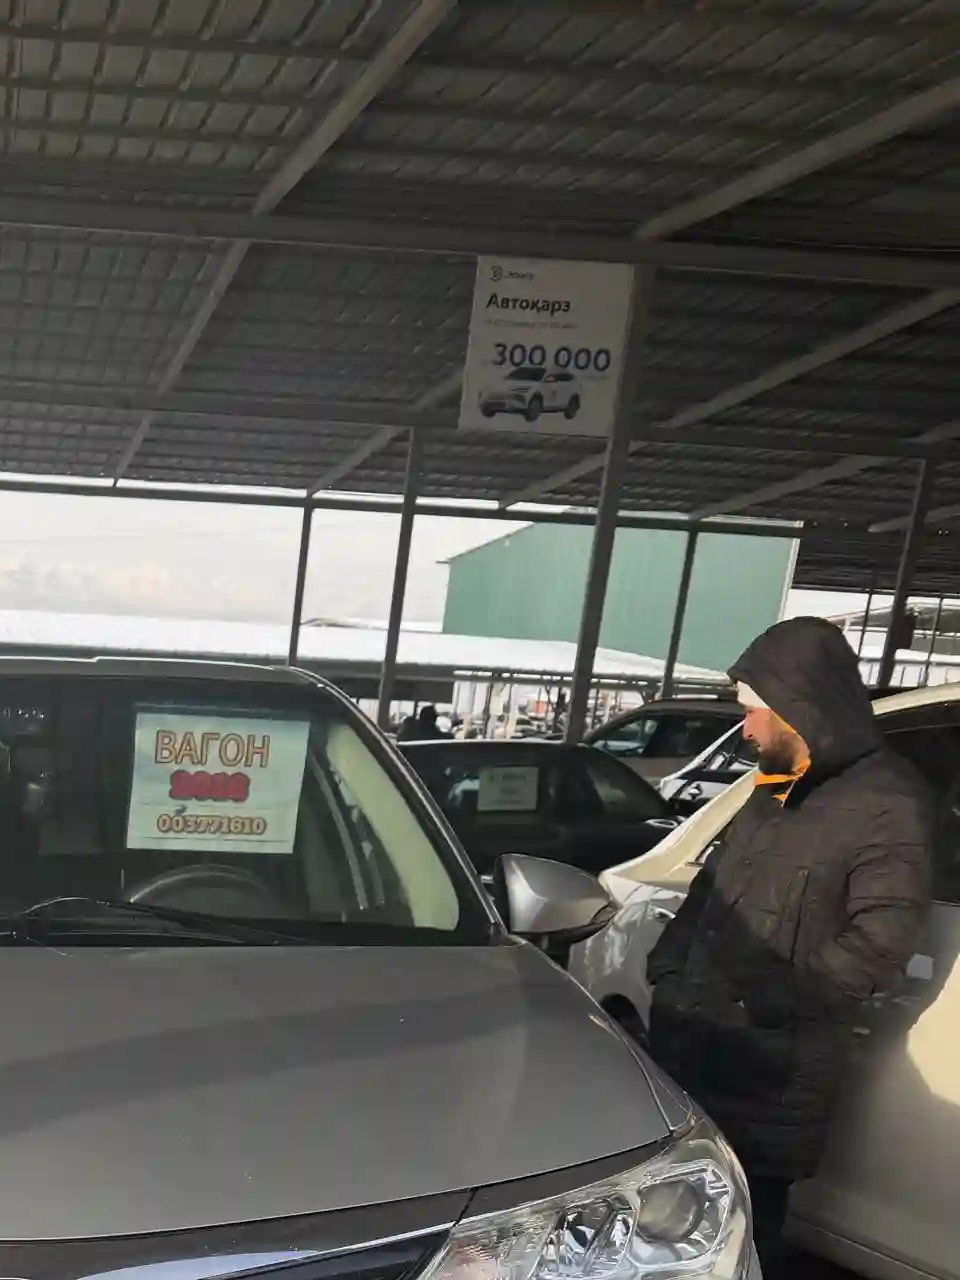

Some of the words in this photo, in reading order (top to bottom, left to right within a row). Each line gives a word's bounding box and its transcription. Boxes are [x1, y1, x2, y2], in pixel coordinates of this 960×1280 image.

[492, 342, 547, 368] 300
[553, 346, 612, 372] 000
[154, 730, 271, 768] ВАГОН
